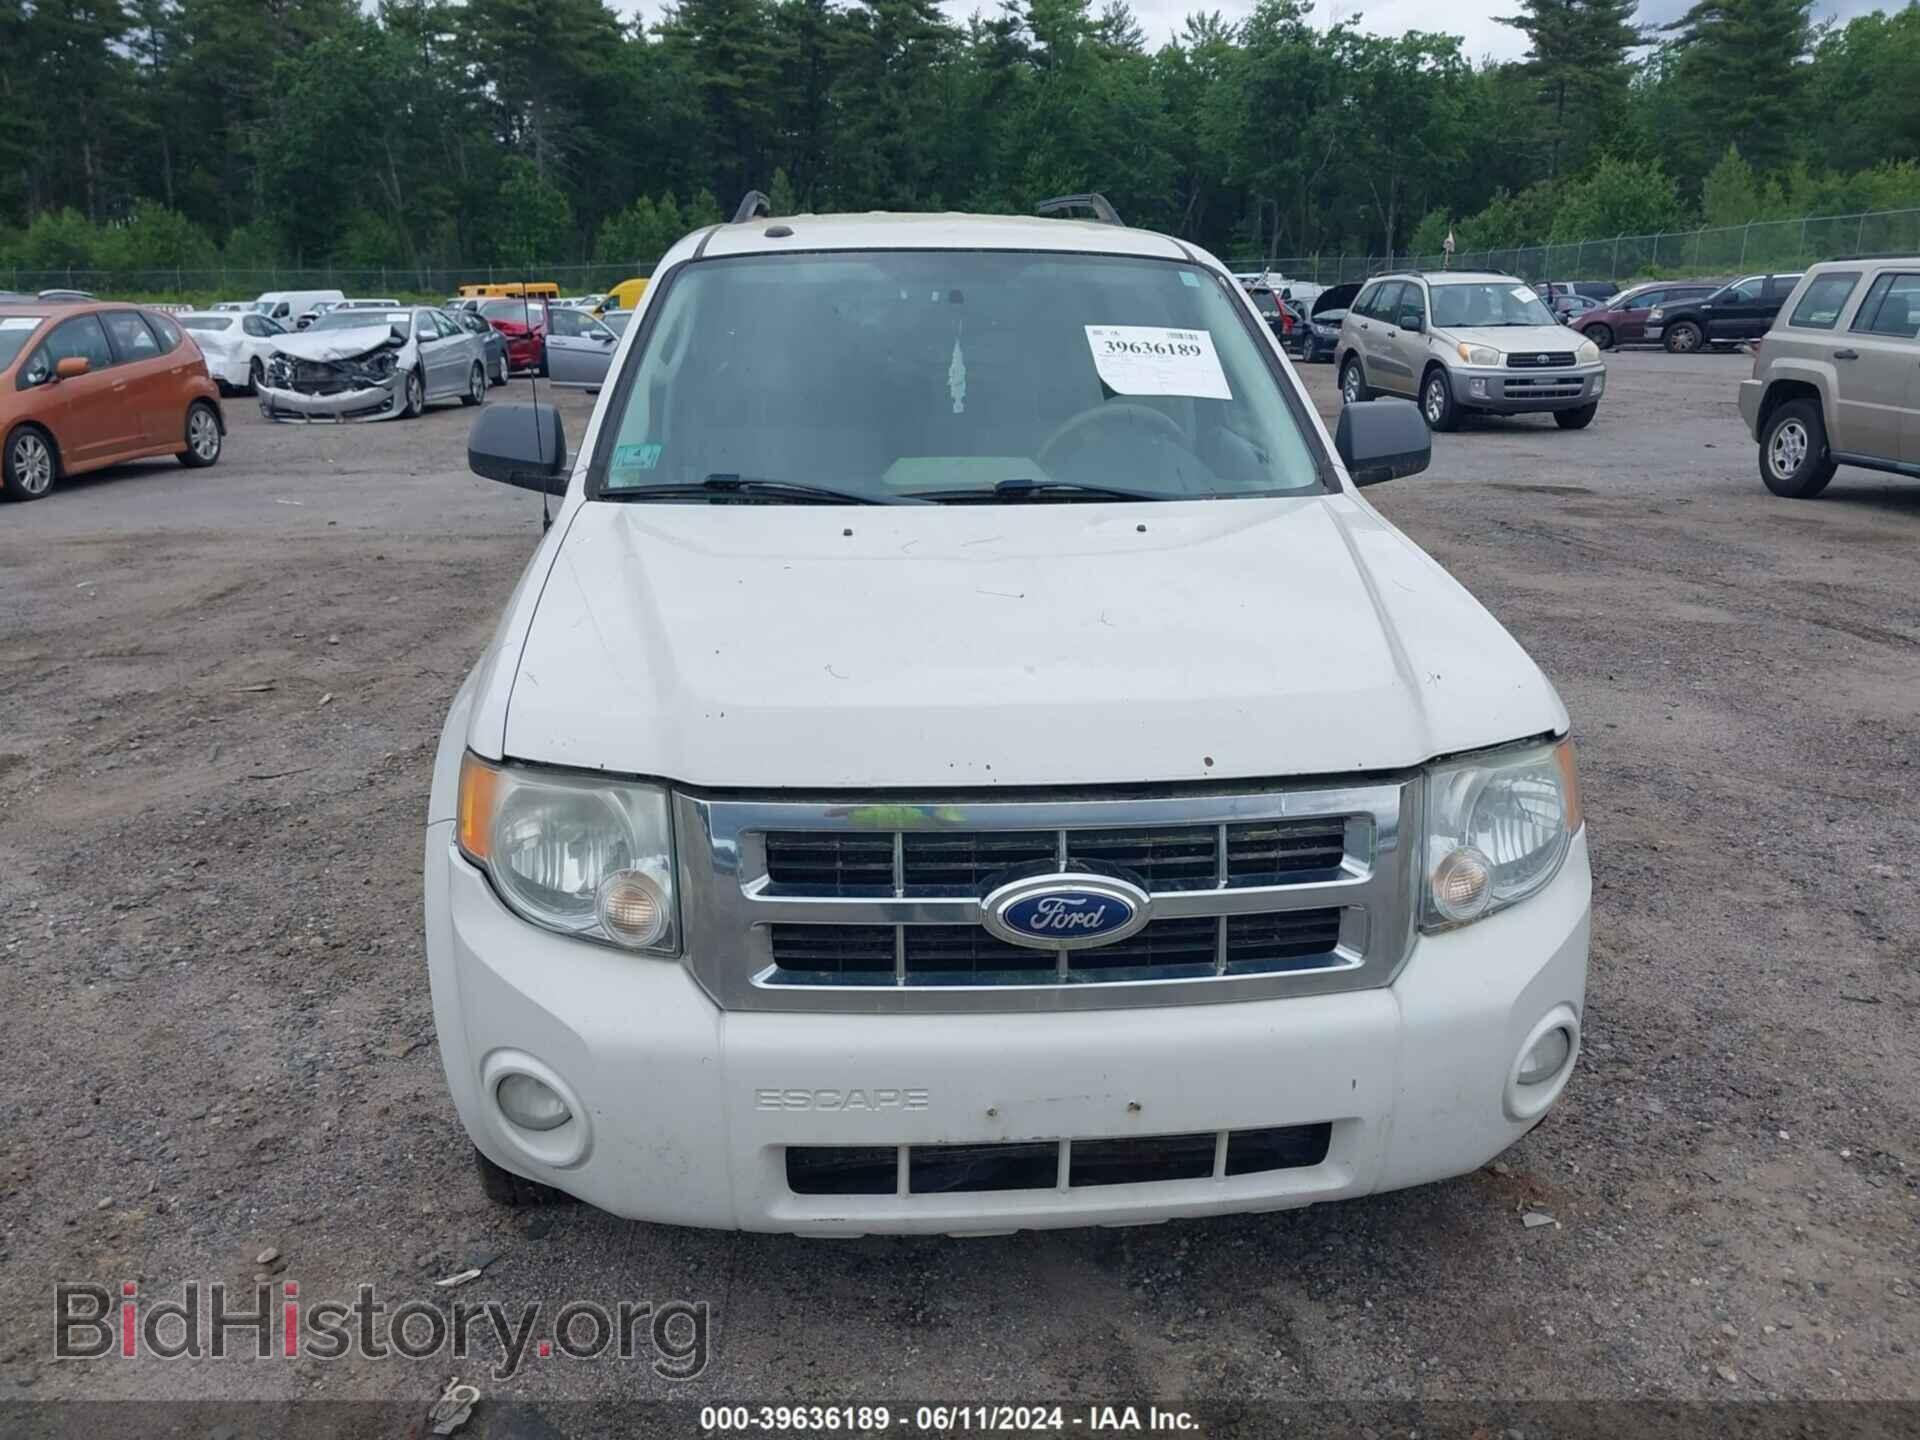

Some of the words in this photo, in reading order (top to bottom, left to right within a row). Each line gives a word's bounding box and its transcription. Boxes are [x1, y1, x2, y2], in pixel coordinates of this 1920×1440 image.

[1104, 340, 1201, 357] 39636189
[1030, 898, 1106, 929] Ford
[755, 1089, 928, 1112] ESCAPE
